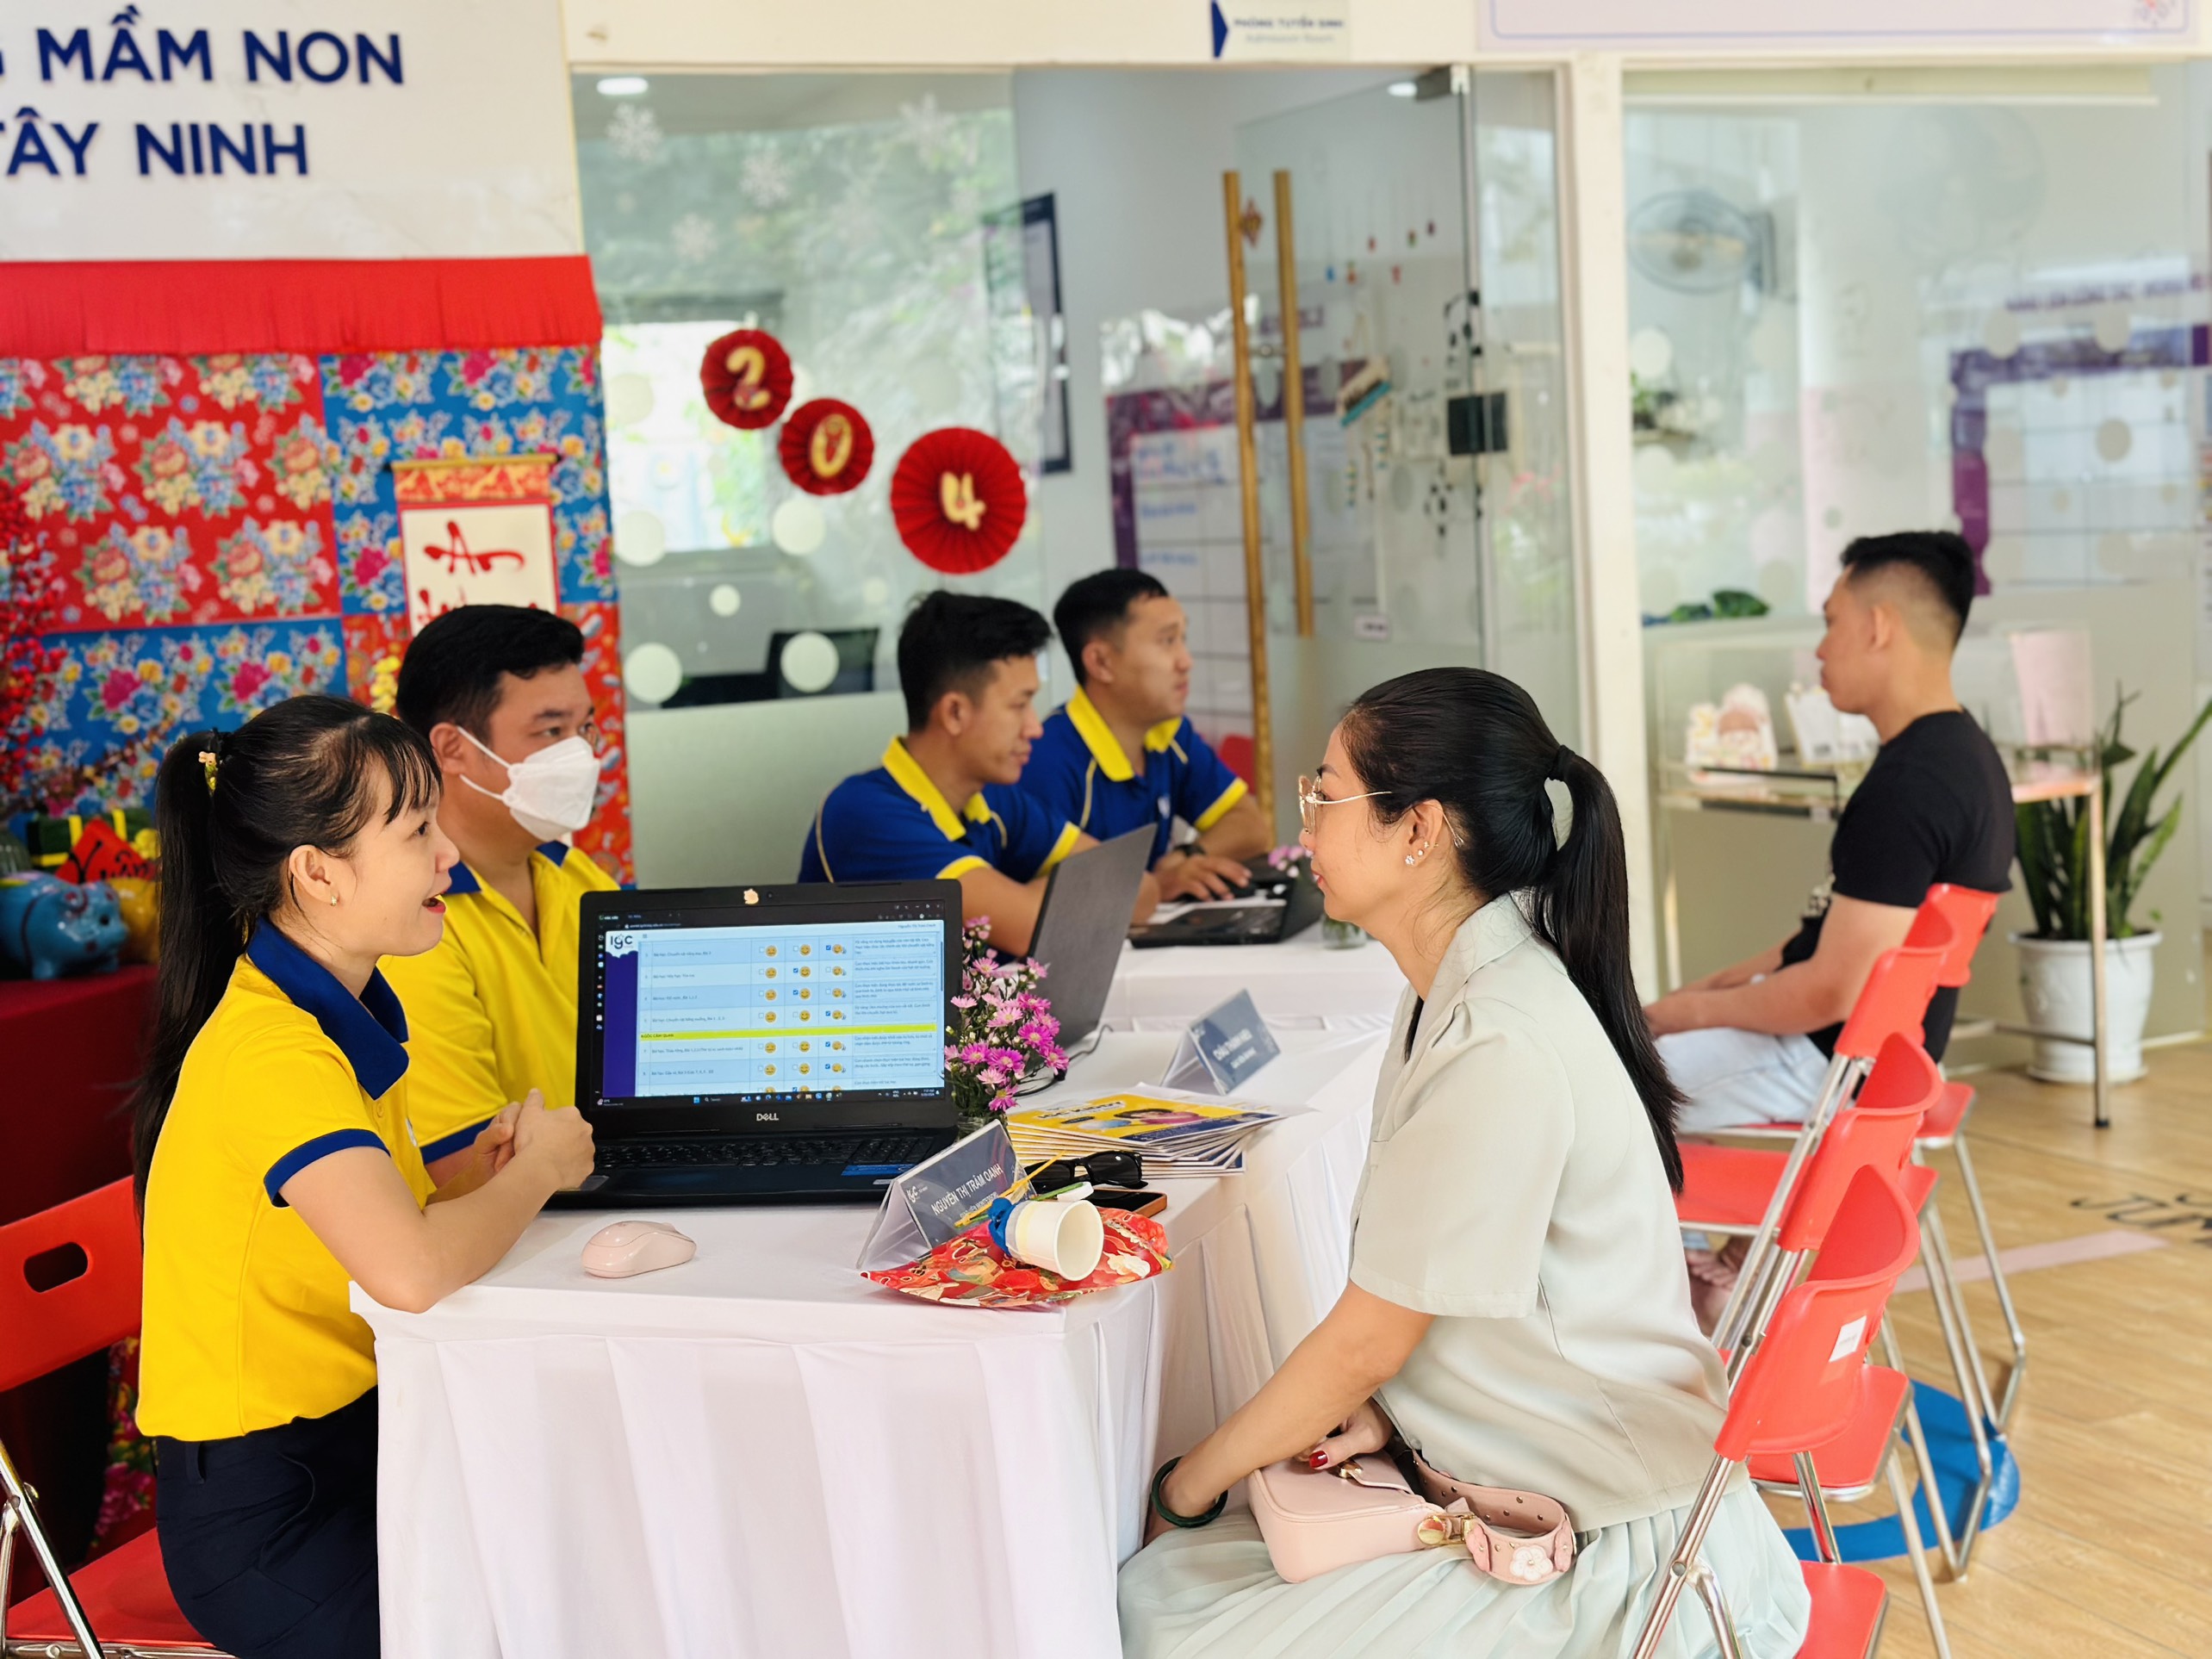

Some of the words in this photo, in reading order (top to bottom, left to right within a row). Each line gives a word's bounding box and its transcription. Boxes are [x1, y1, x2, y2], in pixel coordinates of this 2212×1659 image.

[36, 4, 213, 83] MẦM
[244, 30, 404, 85] NON
[0, 107, 99, 176] ÂY
[135, 123, 308, 176] NINH
[726, 346, 771, 411] 2
[941, 471, 985, 531] 4
[755, 1112, 780, 1122] DELL
[955, 1184, 972, 1199] THỊ
[983, 1163, 1003, 1182] OANH
